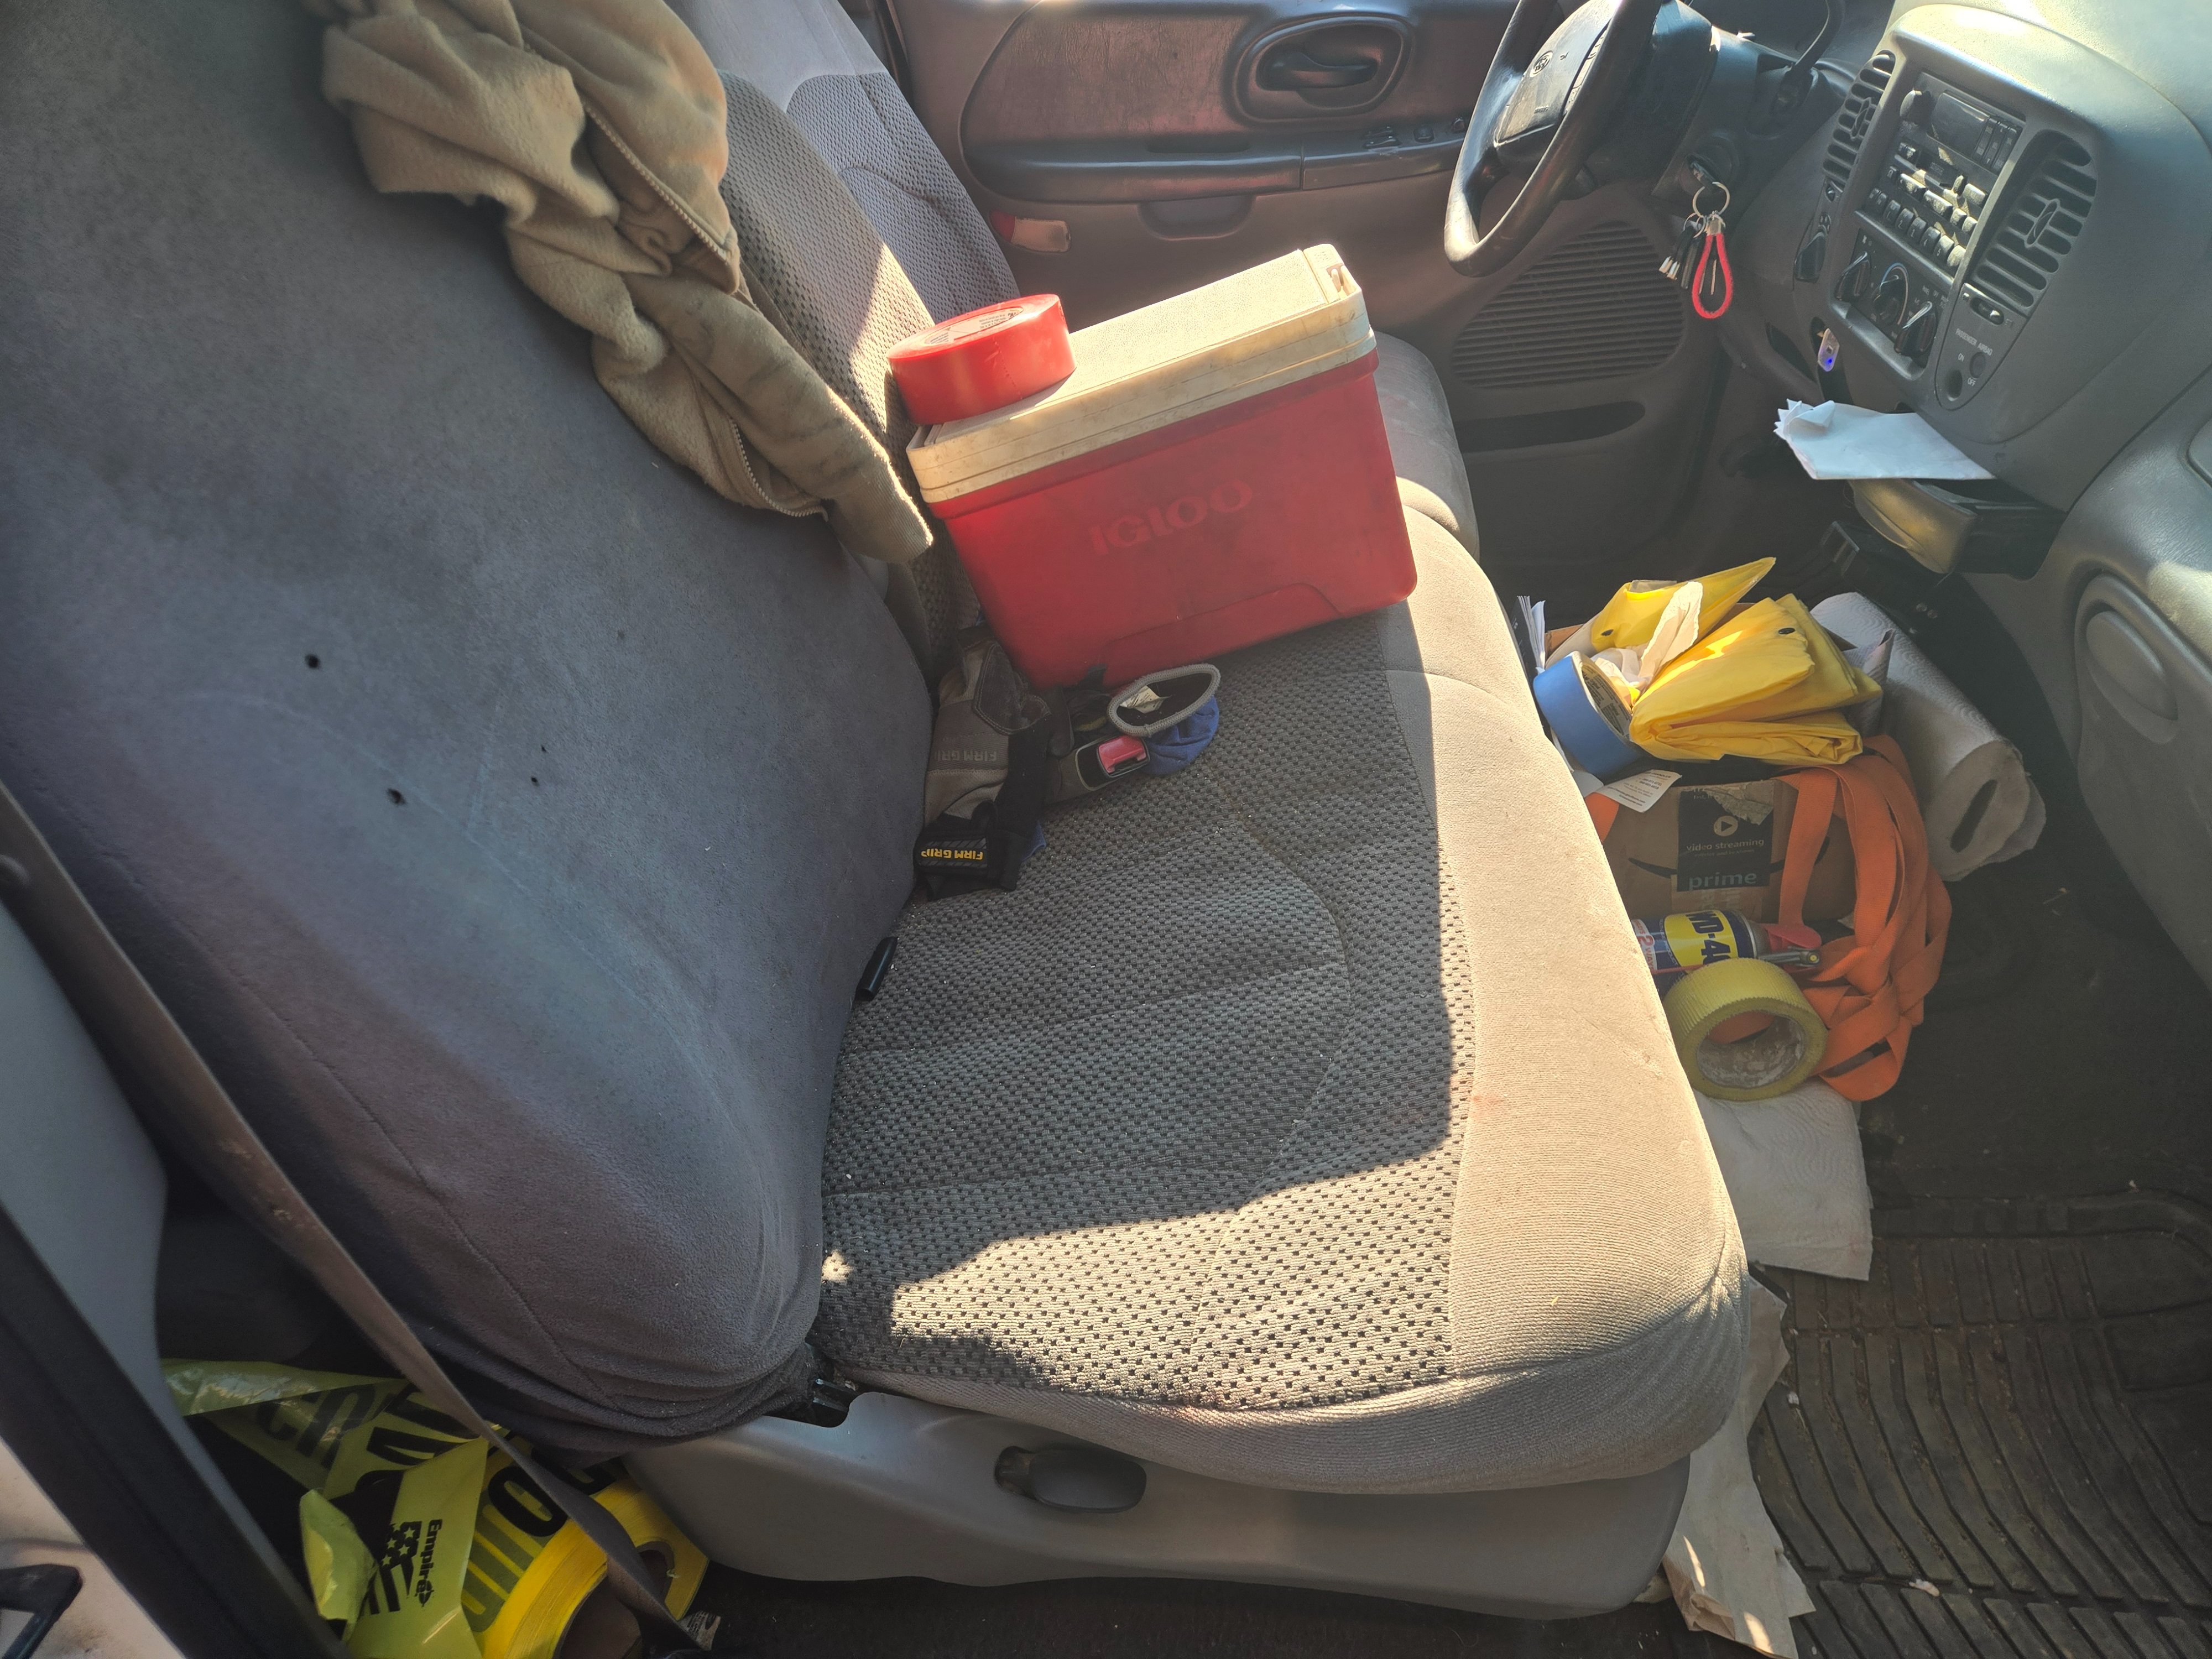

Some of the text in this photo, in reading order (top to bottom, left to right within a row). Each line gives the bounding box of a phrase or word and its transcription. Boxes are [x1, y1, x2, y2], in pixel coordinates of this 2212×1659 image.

[1955, 328, 1993, 356] PASSENGER AIRBAG
[1958, 353, 1965, 362] ON
[1968, 377, 1976, 387] OFF
[1088, 479, 1253, 555] IGLOO
[964, 749, 997, 761] FIRM
[1686, 839, 1764, 852] video streaming
[921, 848, 983, 860] FIRM GRIP
[1689, 872, 1757, 890] prime
[1637, 935, 1654, 947] 2
[415, 1519, 442, 1608] Empire
